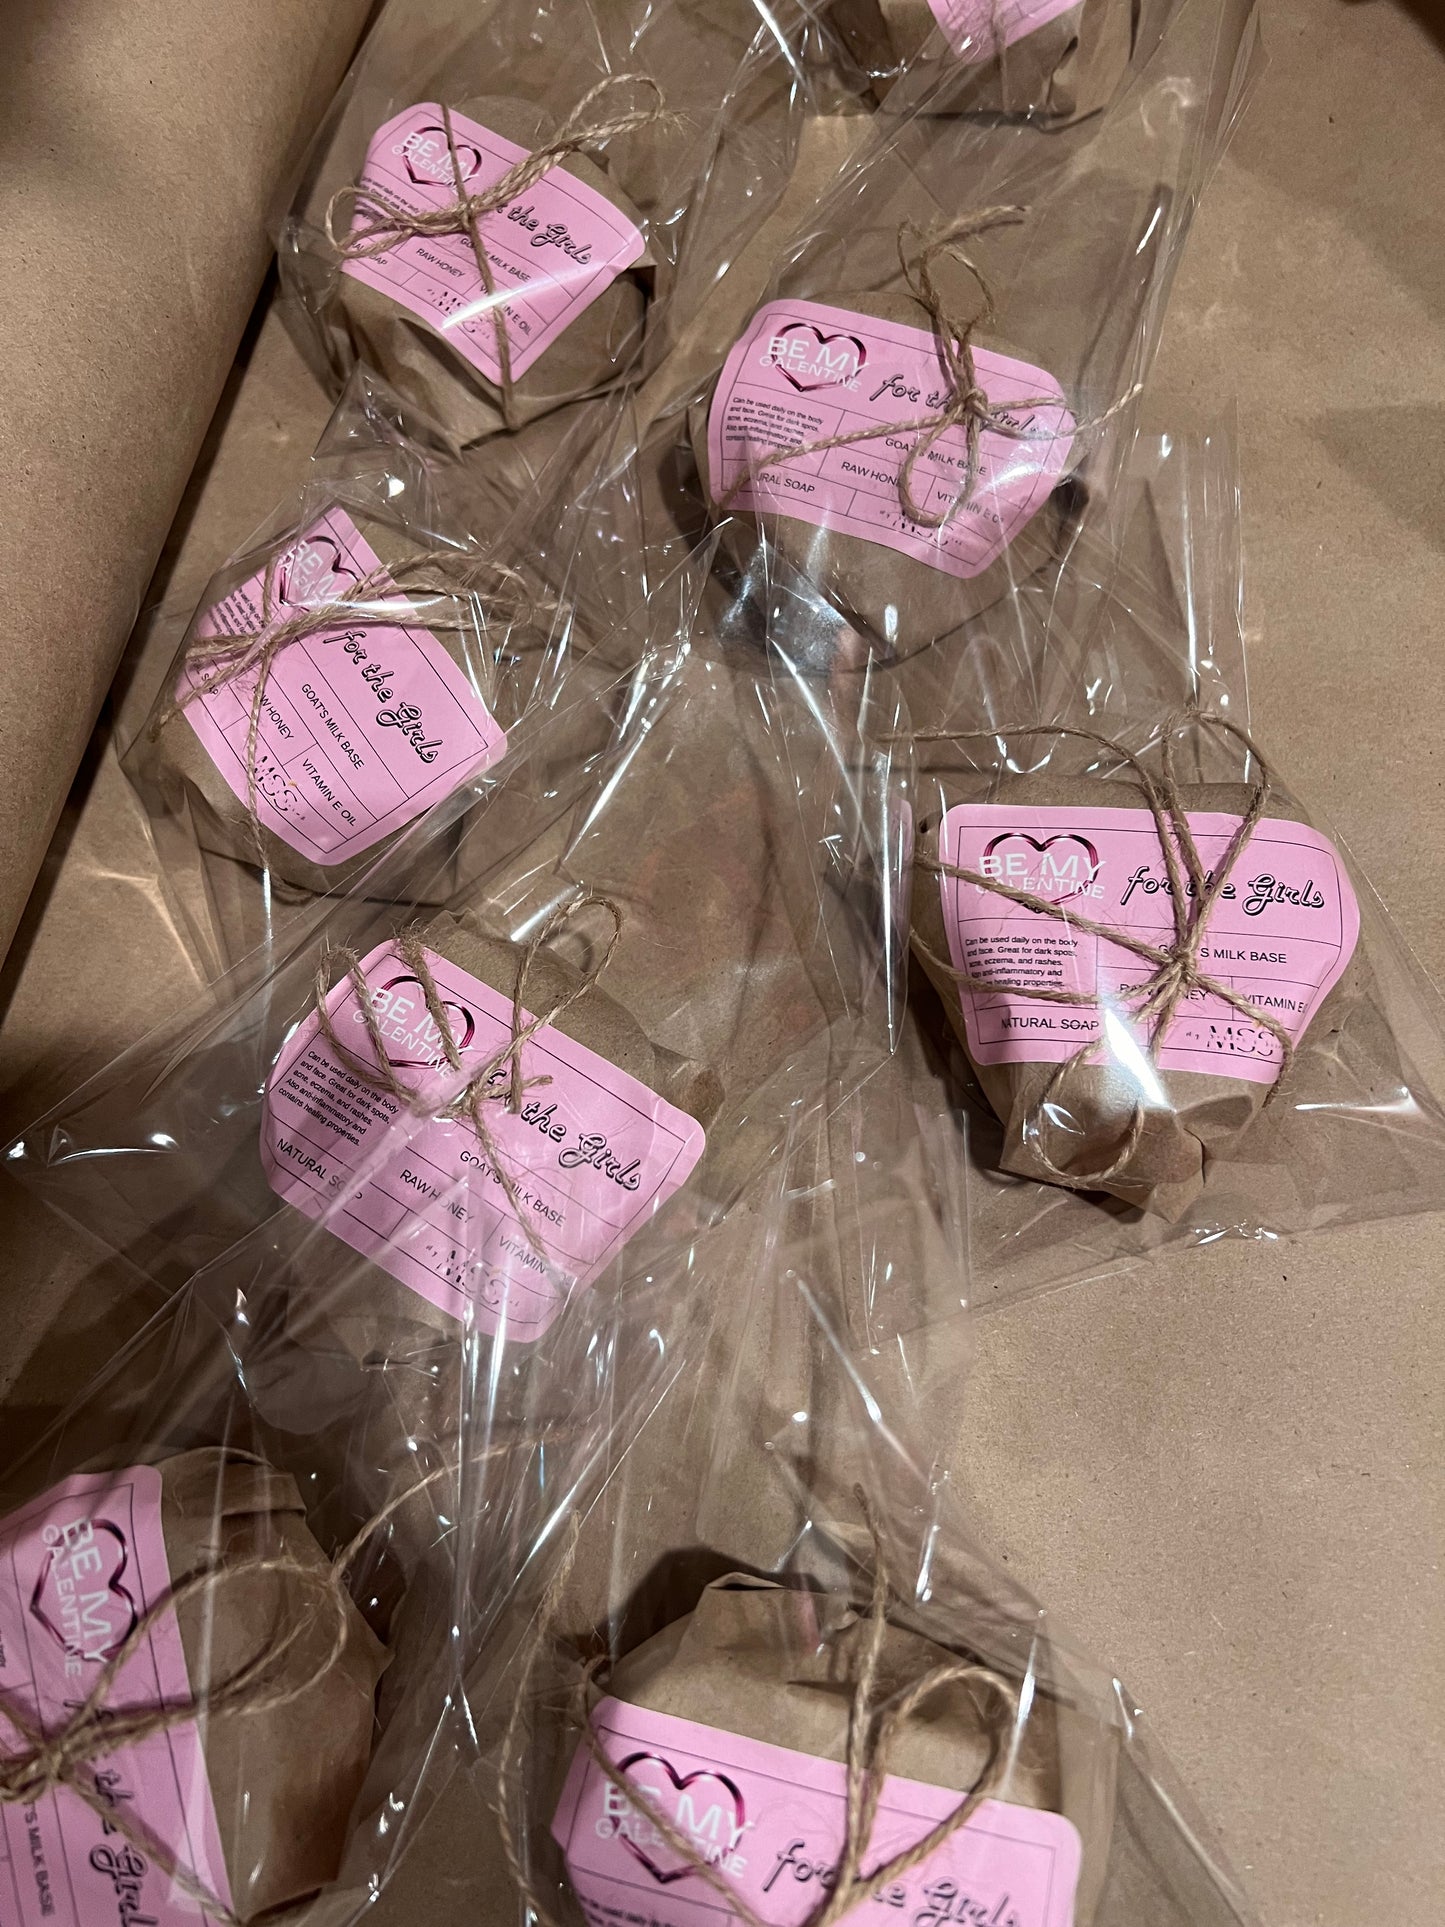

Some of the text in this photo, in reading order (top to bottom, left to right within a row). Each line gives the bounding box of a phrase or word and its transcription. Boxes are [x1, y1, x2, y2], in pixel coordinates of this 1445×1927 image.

[401, 132, 440, 157] BE
[530, 223, 593, 264] Girls
[416, 248, 466, 279] RAW HONEY
[508, 266, 532, 283] BASE
[759, 355, 862, 393] GALENTINE
[767, 336, 870, 377] BE MY
[869, 373, 921, 403] for
[841, 461, 870, 479] RAW
[927, 450, 956, 466] MILK
[783, 478, 816, 493] SOAP
[322, 630, 444, 763] for the Girls
[265, 705, 295, 740] HONEY
[301, 683, 365, 770] GOAT'S MILK BASE
[302, 758, 358, 827] VITAMIN E OIL
[978, 852, 1107, 882] BE MY
[1242, 873, 1326, 917] Girls
[978, 936, 989, 944] be
[990, 936, 1010, 944] used
[1011, 936, 1030, 945] daily
[1044, 937, 1057, 946] the
[997, 946, 1020, 955] Great
[1021, 946, 1033, 955] for
[1034, 947, 1052, 956] dark
[1213, 948, 1247, 961] MILK
[1250, 951, 1288, 964] BASE
[1017, 957, 1033, 966] and
[1047, 969, 1063, 977] and
[371, 987, 416, 1025] BE
[1060, 1018, 1100, 1031] SOAP
[300, 1060, 313, 1071] and
[328, 1077, 348, 1091] Great
[346, 1088, 356, 1100] for
[355, 1096, 372, 1111] dark
[307, 1050, 399, 1115] Can be used daily on the body
[278, 1087, 304, 1108] contains
[303, 1102, 328, 1124] healing
[286, 1078, 367, 1136] Also anti-inflammatory and
[336, 1098, 351, 1110] and
[276, 1137, 327, 1180] NATURAL
[520, 1101, 642, 1192] the Girls
[400, 1169, 475, 1224] RAW HONEY
[532, 1198, 567, 1228] BASE
[499, 1235, 546, 1274] VITAMIN
[61, 1517, 103, 1582] BE
[41, 1523, 83, 1679] GALENTINE
[79, 1589, 113, 1664] MY
[675, 1793, 756, 1853] MY
